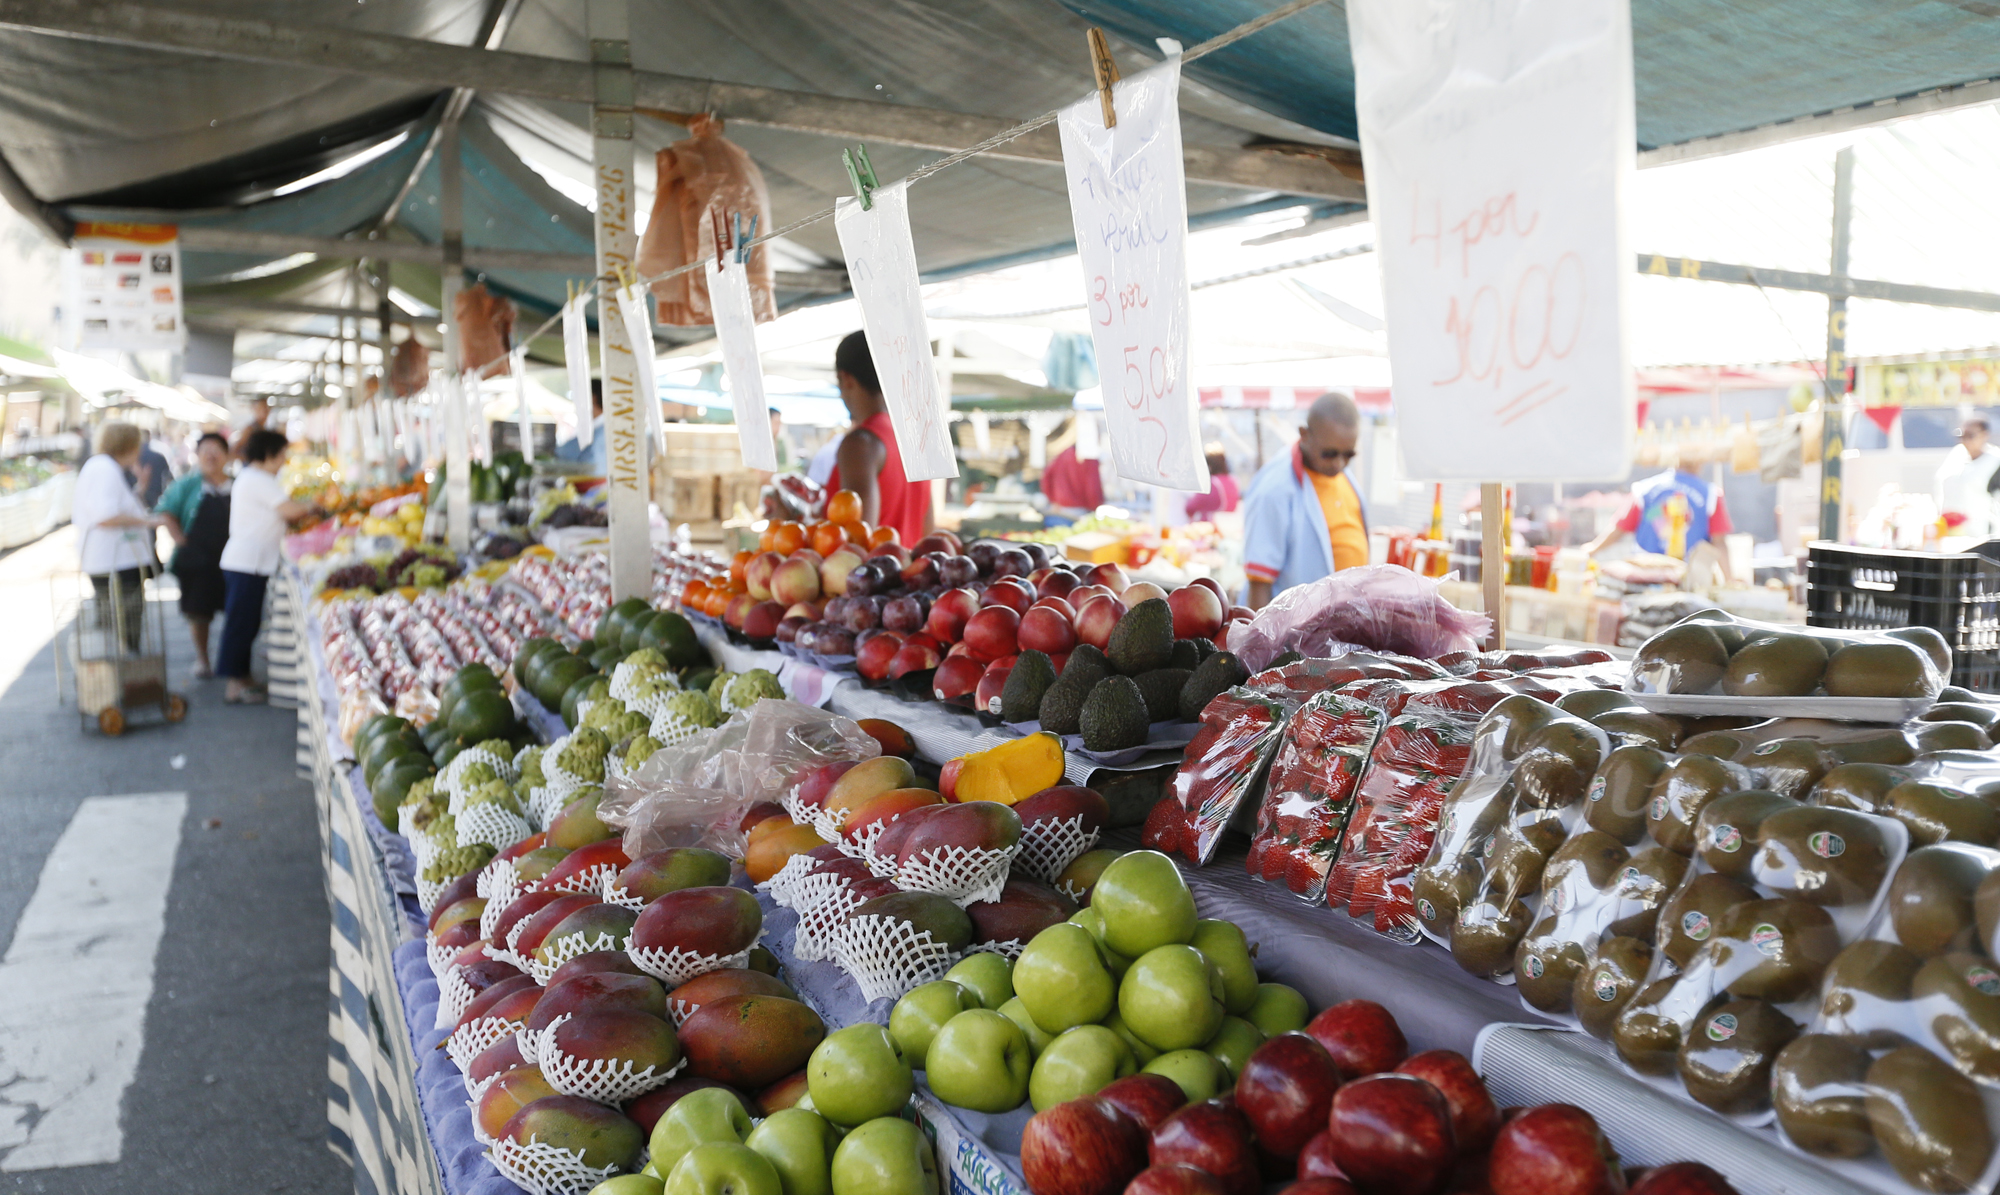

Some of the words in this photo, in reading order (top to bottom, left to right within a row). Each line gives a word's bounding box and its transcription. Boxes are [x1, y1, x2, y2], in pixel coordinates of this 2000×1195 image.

[1410, 179, 1443, 268] 4
[1094, 274, 1113, 327] 3
[1119, 282, 1149, 326] por
